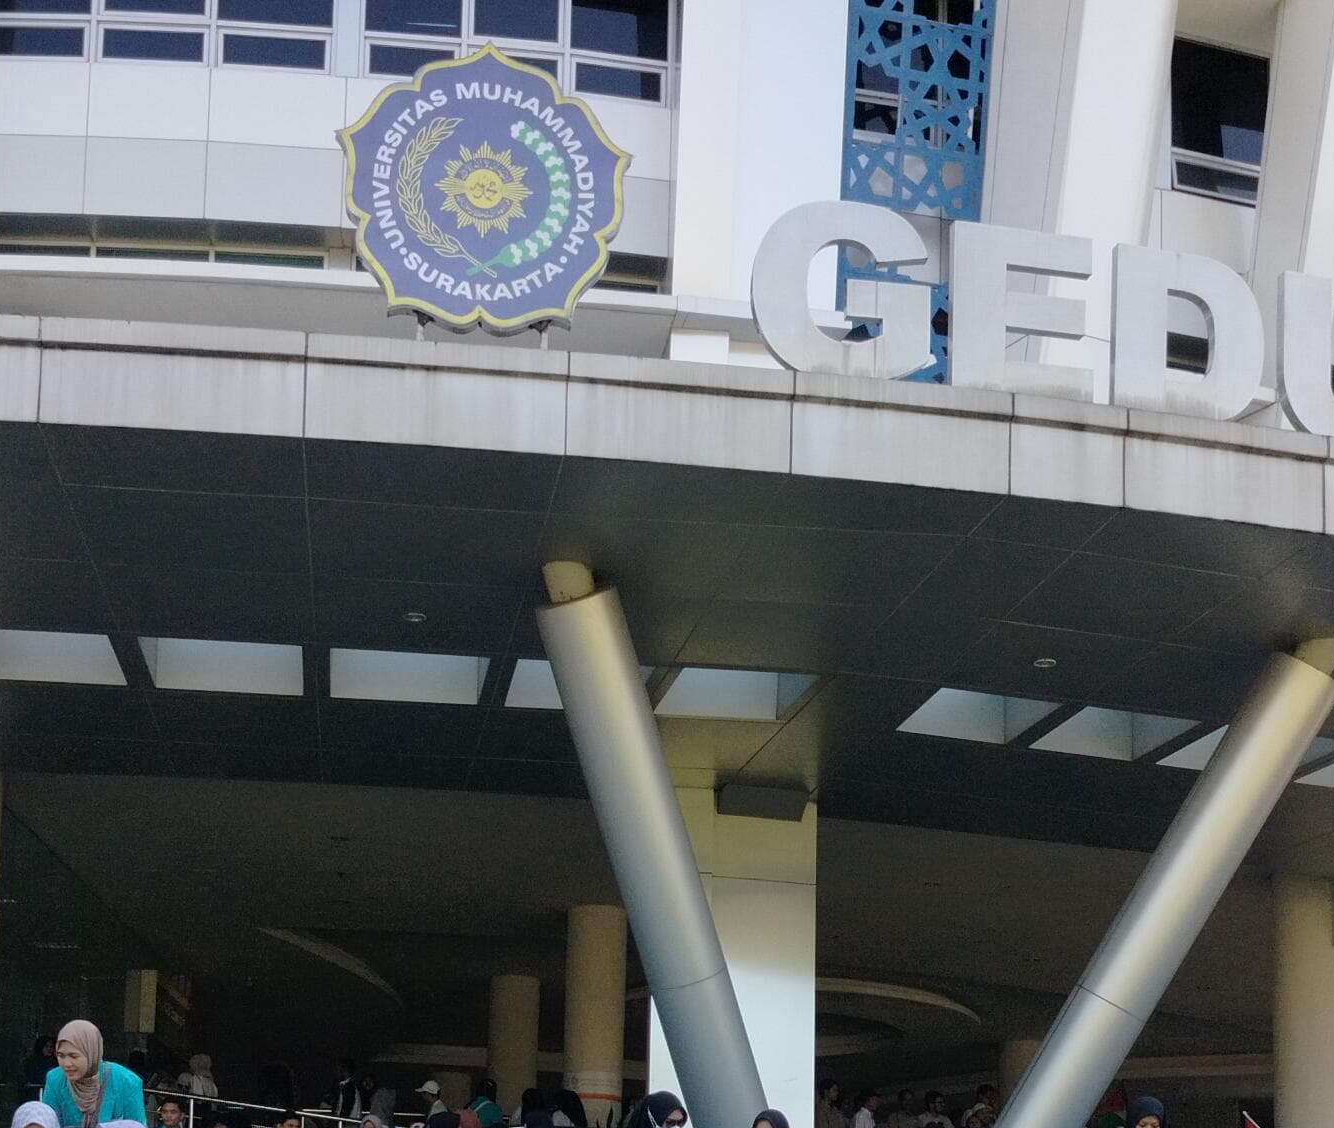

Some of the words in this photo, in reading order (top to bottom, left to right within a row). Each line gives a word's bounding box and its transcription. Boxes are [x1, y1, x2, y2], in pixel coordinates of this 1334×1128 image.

[372, 89, 448, 249] UNIVERSITAS
[455, 81, 595, 256] MUHAMMADIYAH
[402, 251, 565, 302] SURAKARTA
